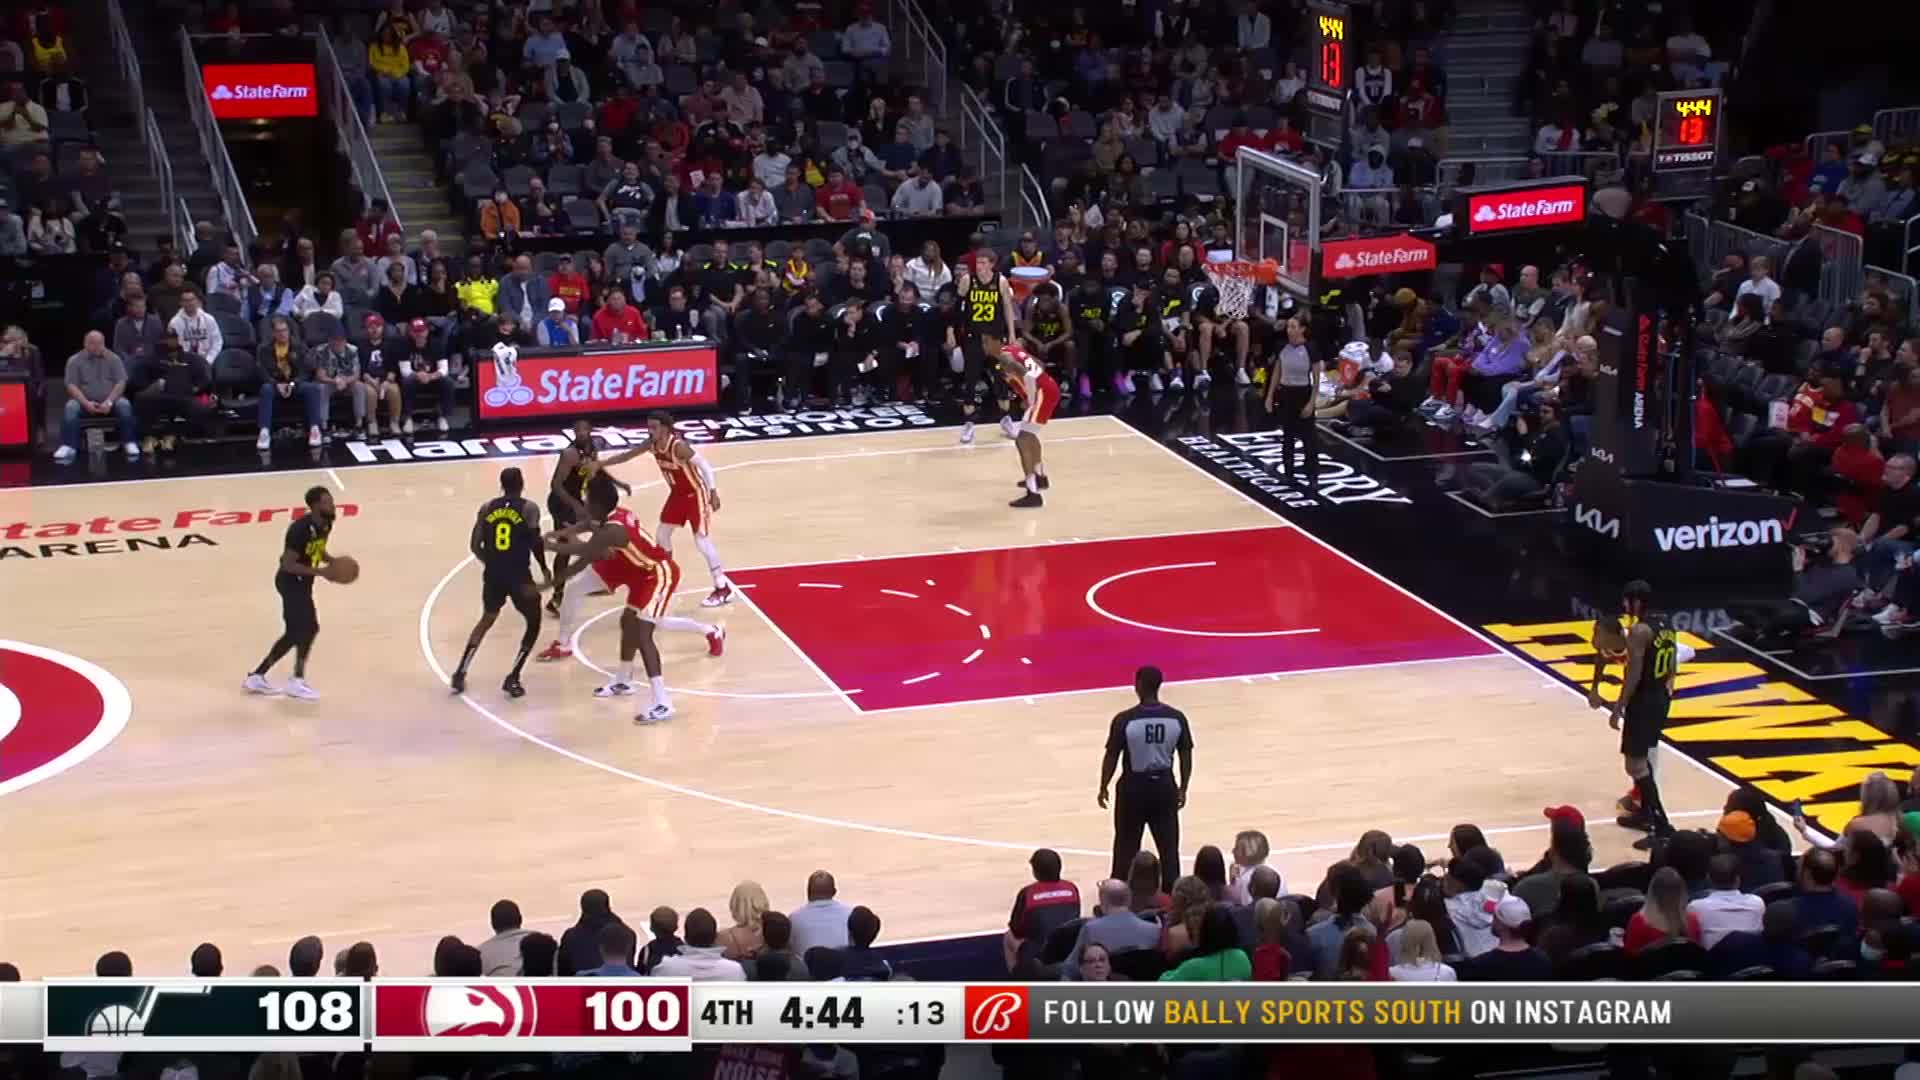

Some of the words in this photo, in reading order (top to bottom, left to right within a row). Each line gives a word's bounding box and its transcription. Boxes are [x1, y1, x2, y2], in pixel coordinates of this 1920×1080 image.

[1323, 43, 1340, 88] 13
[1680, 118, 1703, 143] 13
[970, 290, 999, 303] UTAH
[972, 303, 995, 322] 23
[673, 404, 925, 431] CHEROKEE
[683, 414, 936, 441] CASINOS
[1177, 435, 1320, 508] HEALTHCARE
[0, 533, 219, 560] ARENA
[495, 522, 511, 551] 8
[1654, 515, 1784, 551] verizon
[1145, 726, 1165, 745] 60
